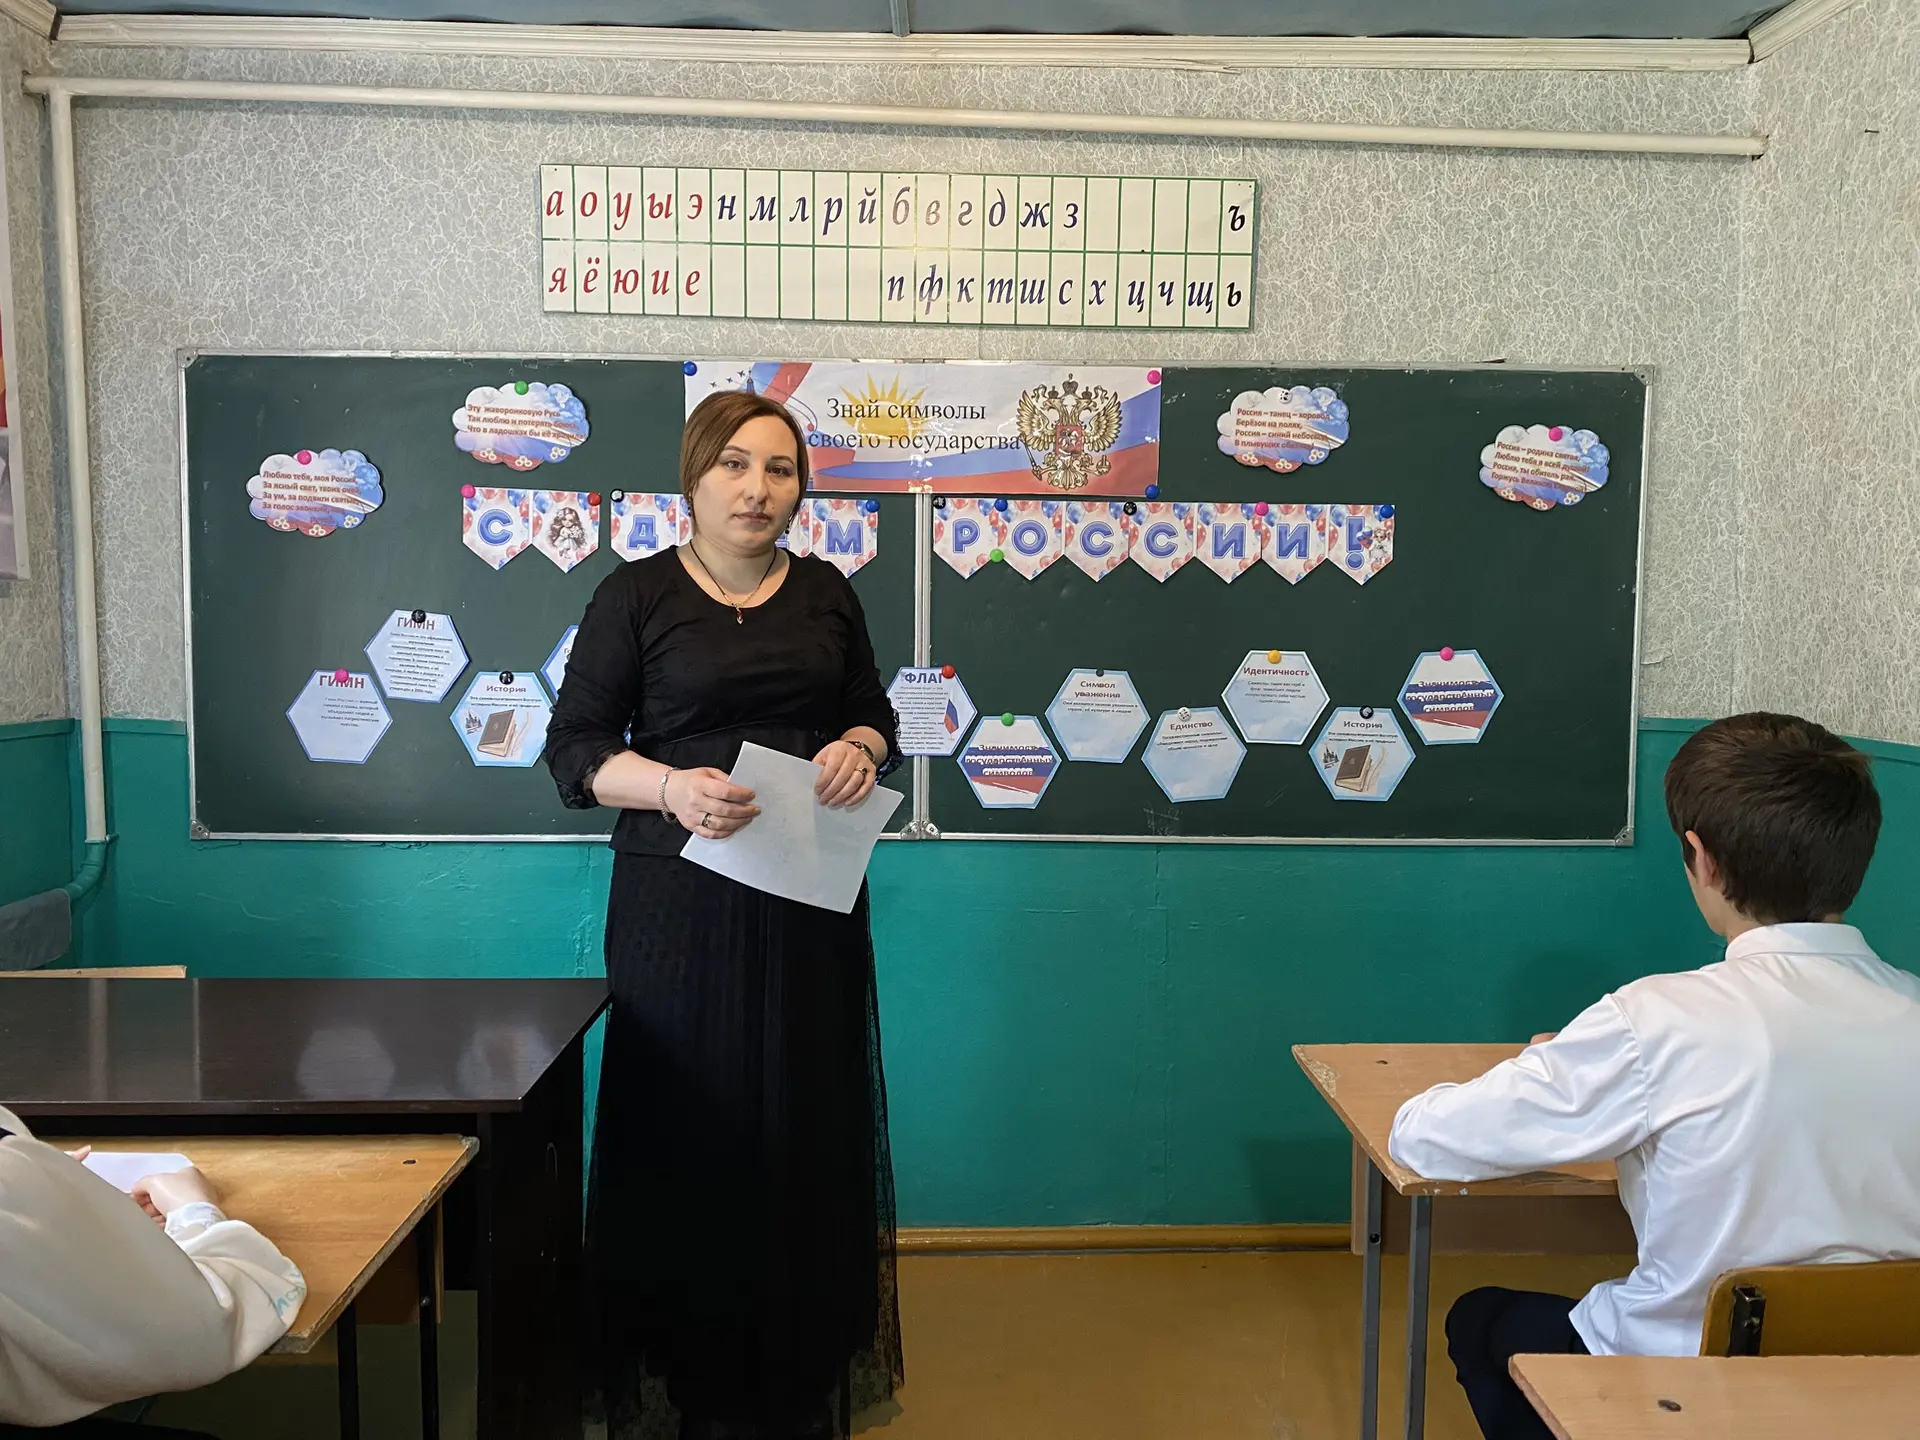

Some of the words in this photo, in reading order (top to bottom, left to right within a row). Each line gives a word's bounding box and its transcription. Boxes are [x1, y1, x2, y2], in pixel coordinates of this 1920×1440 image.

[546, 190, 565, 217] а
[579, 191, 598, 218] о
[612, 191, 633, 231] у
[646, 192, 673, 220] ы
[686, 193, 703, 220] э
[717, 194, 737, 221] н
[748, 195, 777, 222] м
[788, 196, 810, 223] л
[822, 197, 843, 236] р
[857, 186, 877, 225] й
[892, 186, 911, 226] б
[925, 199, 941, 226] в
[957, 200, 973, 227] г
[988, 188, 1006, 228] д
[1019, 201, 1051, 229] ж
[1063, 202, 1079, 229] з
[1227, 205, 1246, 232] ъ
[548, 267, 568, 294] я
[583, 256, 601, 294] ё
[612, 268, 640, 295] ю
[650, 269, 670, 296] и
[685, 270, 701, 297] е
[887, 275, 905, 302] п
[918, 263, 944, 316] ф
[956, 277, 975, 304] к
[986, 277, 1014, 305] т
[1019, 278, 1046, 305] ш
[1058, 279, 1074, 306] с
[1088, 279, 1107, 306] х
[1127, 280, 1146, 314] ц
[1157, 280, 1175, 307] ч
[1187, 281, 1214, 315] щ
[1226, 281, 1242, 308] ь
[466, 404, 481, 414] Эту
[826, 397, 880, 420] Знай
[887, 400, 987, 420] символы
[1237, 408, 1262, 417] Россия
[1270, 410, 1292, 420] танец
[467, 414, 481, 423] Так
[482, 416, 510, 425] люблю
[466, 425, 481, 433] Что
[528, 428, 541, 437] бы
[1235, 429, 1261, 438] Россия
[1268, 430, 1291, 439] синий
[808, 432, 882, 450] своего
[888, 433, 1022, 455] государства
[1496, 441, 1521, 452] Россия
[1494, 452, 1521, 462] Люблю
[1521, 455, 1538, 465] тебя
[1520, 466, 1530, 475] ты
[262, 471, 292, 479] Люблю
[314, 475, 330, 483] моя
[263, 481, 272, 489] За
[273, 482, 298, 490] ясный
[262, 491, 272, 499] За
[262, 502, 272, 510] За
[272, 503, 295, 511] голос
[477, 508, 515, 547] С
[1243, 667, 1310, 677] Идентичность
[486, 684, 527, 695] История
[1080, 680, 1116, 689] Символ
[1074, 691, 1121, 700] уважения
[1170, 721, 1214, 731] Единство
[1343, 720, 1383, 730] История
